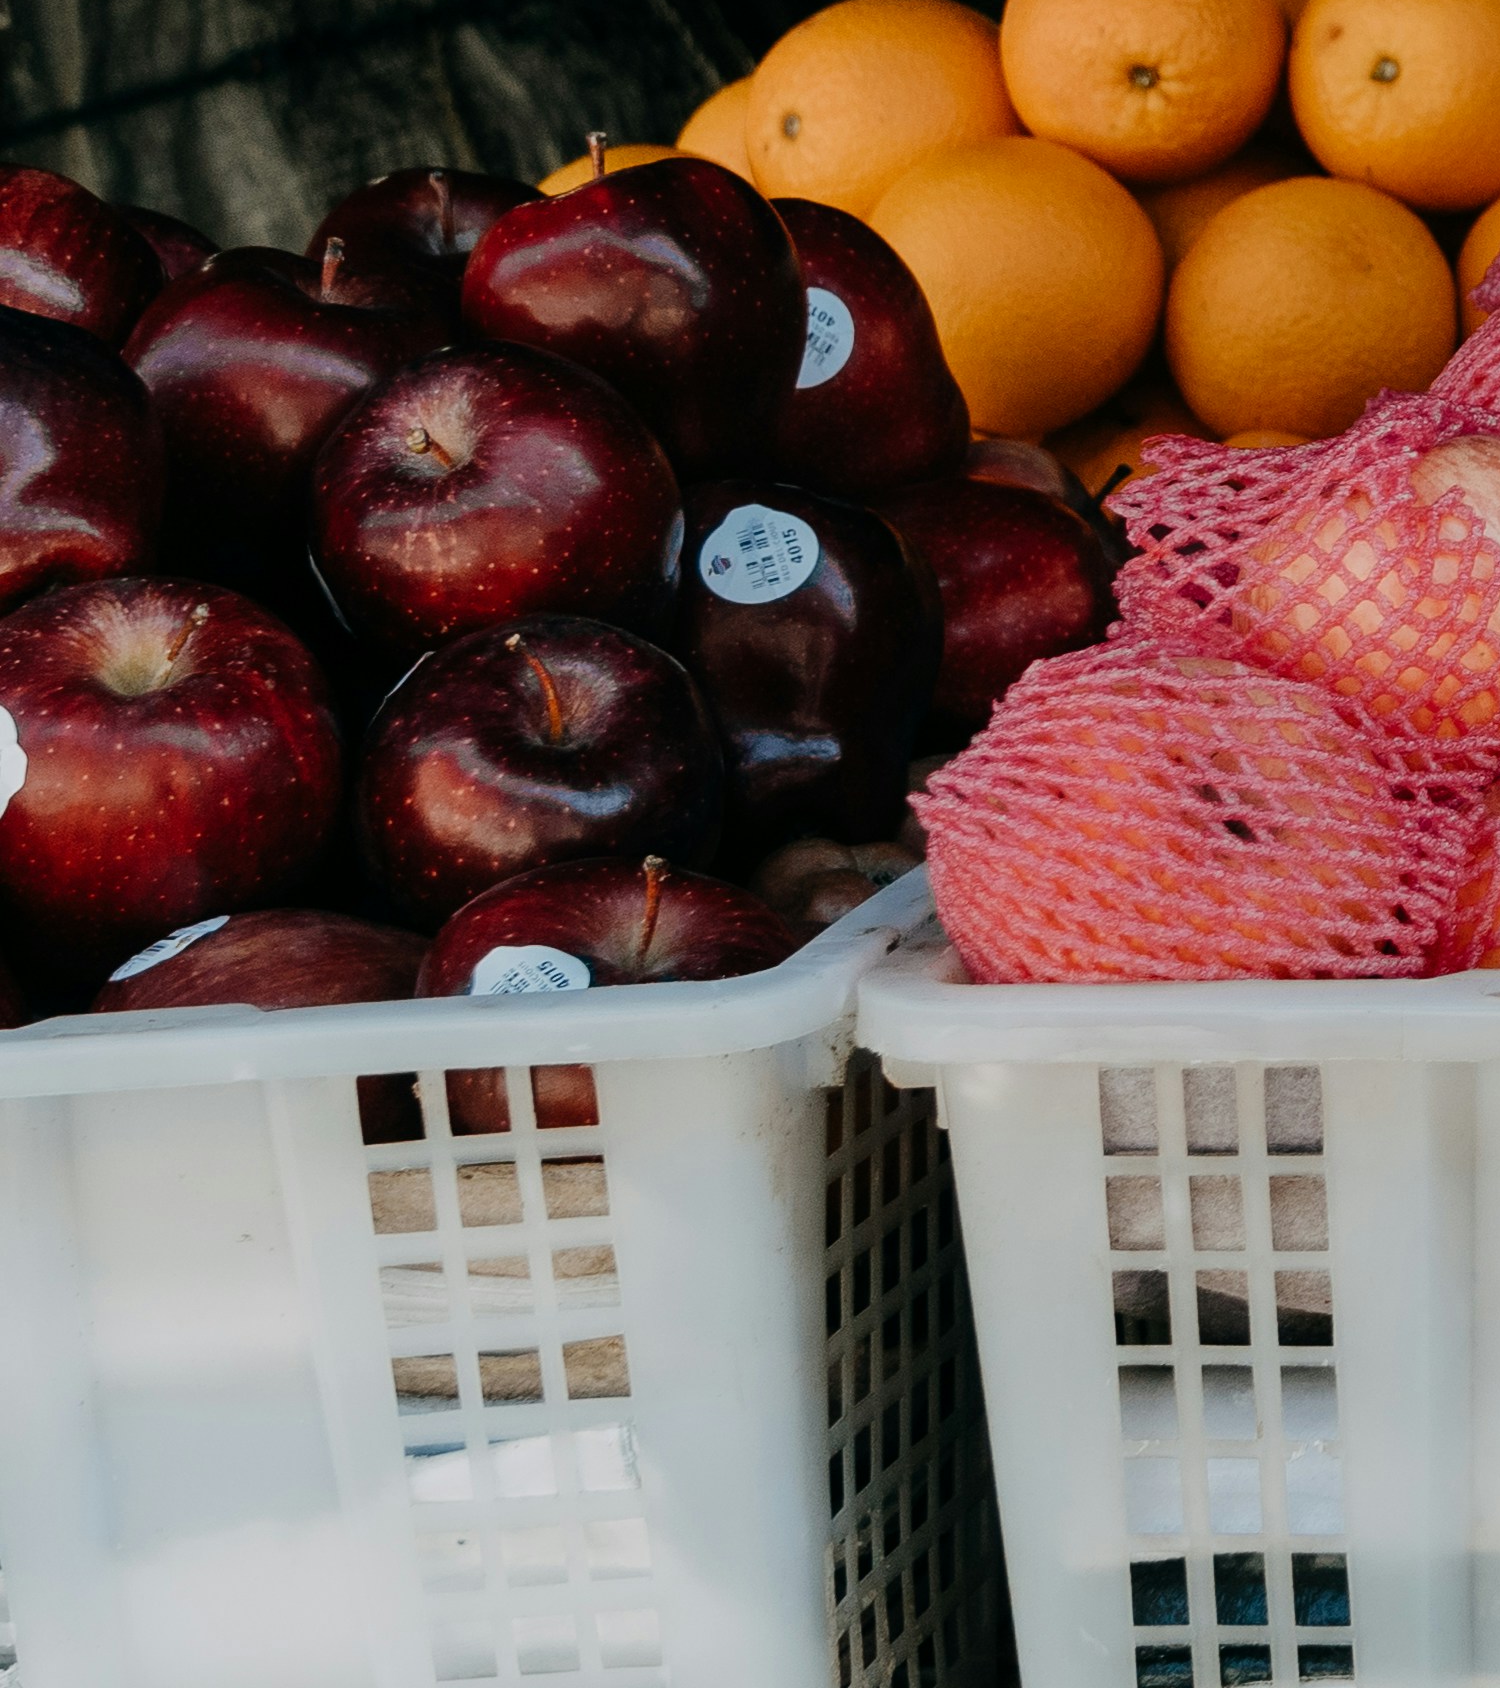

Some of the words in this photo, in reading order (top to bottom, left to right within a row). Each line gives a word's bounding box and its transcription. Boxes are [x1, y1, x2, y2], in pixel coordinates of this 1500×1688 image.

[808, 305, 836, 327] 401
[782, 528, 804, 564] 4015
[537, 960, 571, 989] 4015
